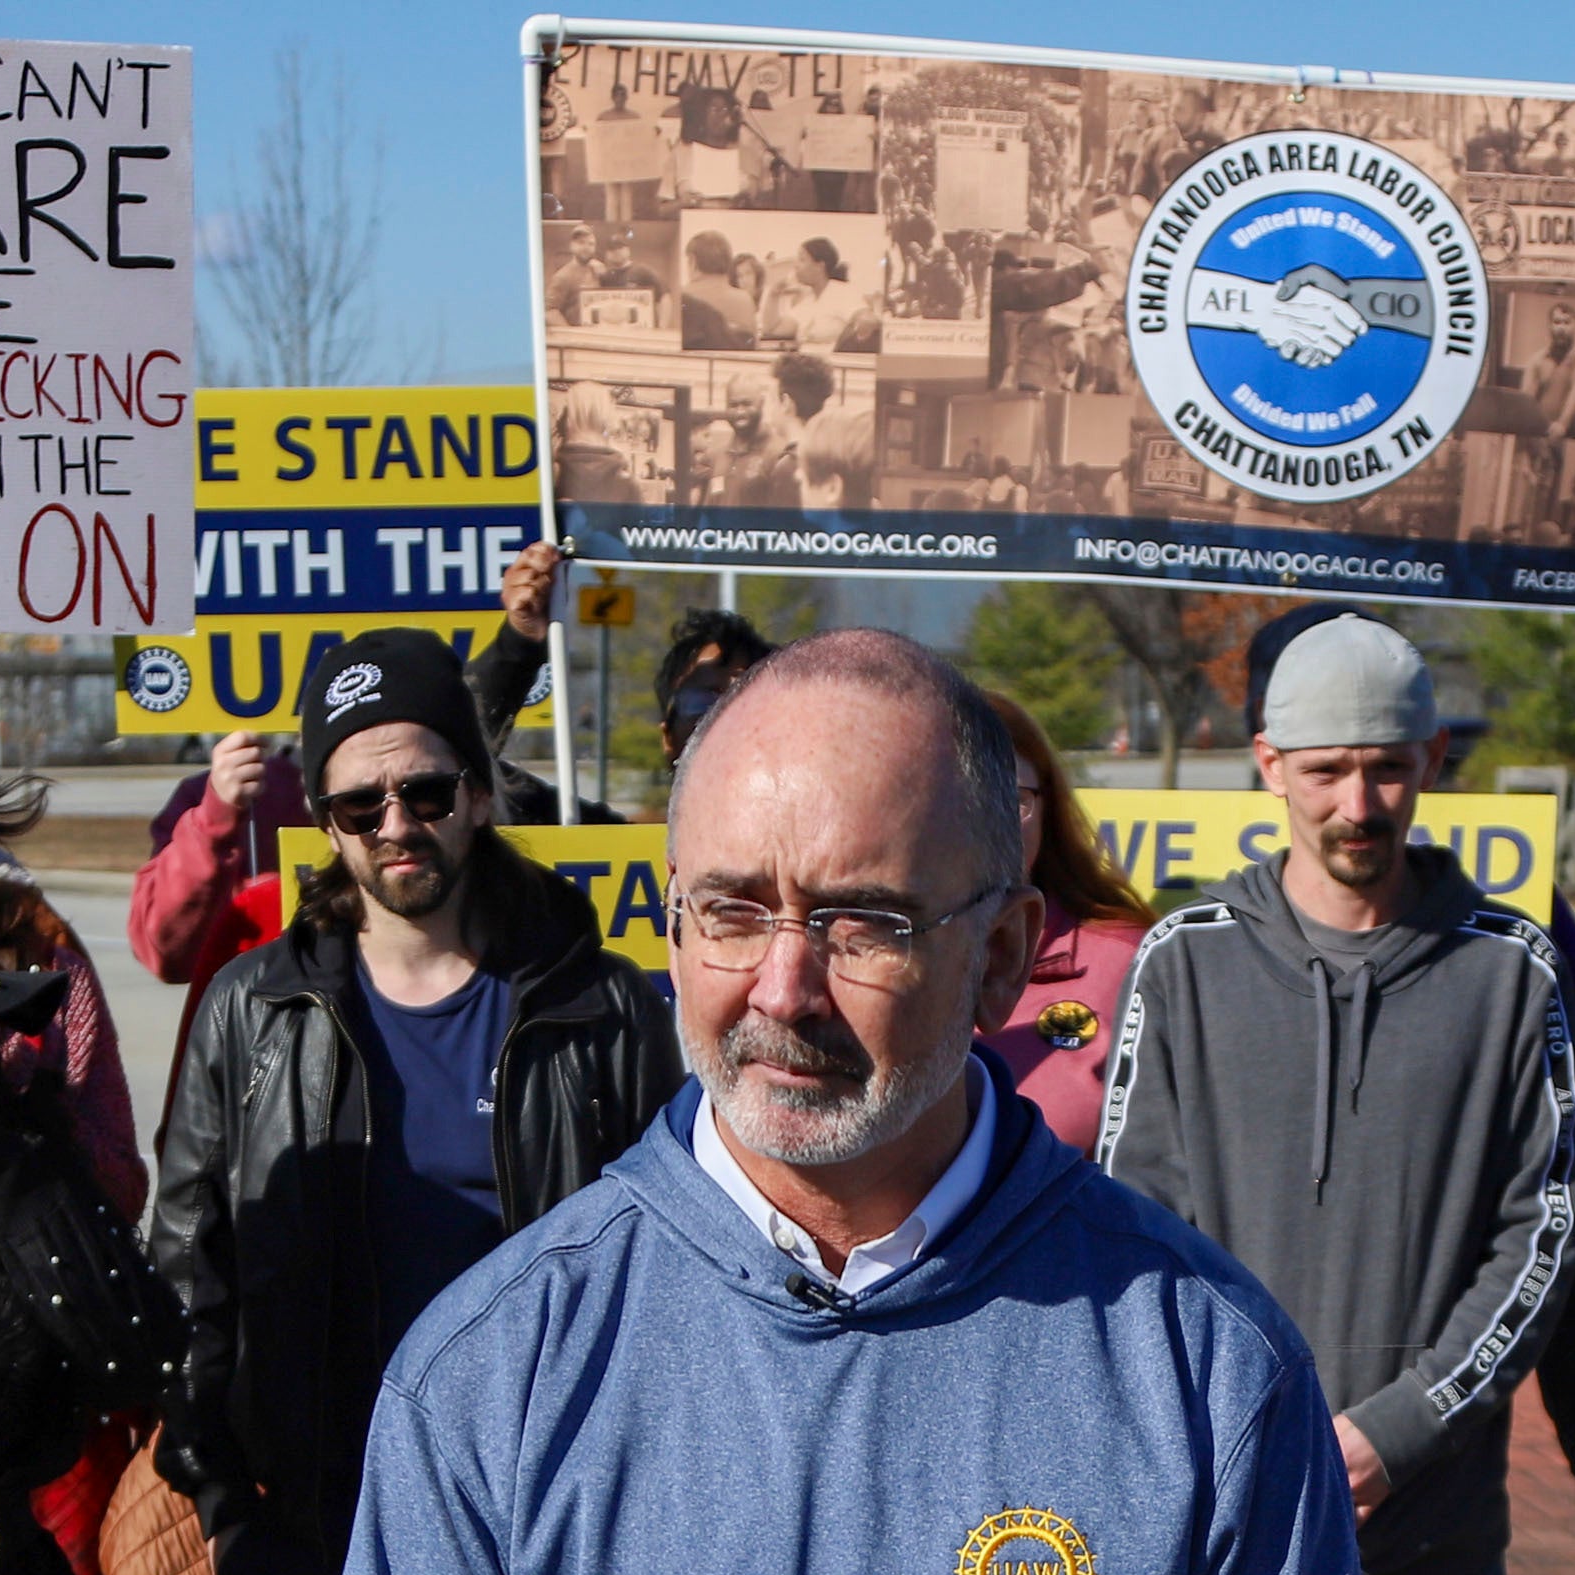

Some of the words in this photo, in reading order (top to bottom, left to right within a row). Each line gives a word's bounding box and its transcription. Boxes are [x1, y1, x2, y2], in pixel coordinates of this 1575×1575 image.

[1139, 152, 1262, 334] CHATTANOOGA
[1267, 143, 1338, 174] AREA
[1347, 150, 1436, 225] LABOR
[1428, 222, 1477, 357] COUNCIL
[1201, 288, 1253, 313] AFL
[1369, 292, 1420, 318] CIO
[19, 432, 134, 496] THE
[198, 417, 240, 482] E
[275, 412, 538, 482] STAND
[1390, 415, 1435, 458] TN
[376, 525, 523, 595] THE
[620, 526, 998, 560] WWW.CHATTANOOGACLC.ORG
[1074, 537, 1445, 586] INFO@CHATTANOOGACLC.ORG
[1122, 992, 1142, 1056] AERO
[1545, 999, 1568, 1055] AERO
[1104, 1085, 1126, 1146] AERO
[1546, 1178, 1567, 1232] AERO
[1519, 1250, 1556, 1307] AERO
[1475, 1322, 1513, 1374] AERO
